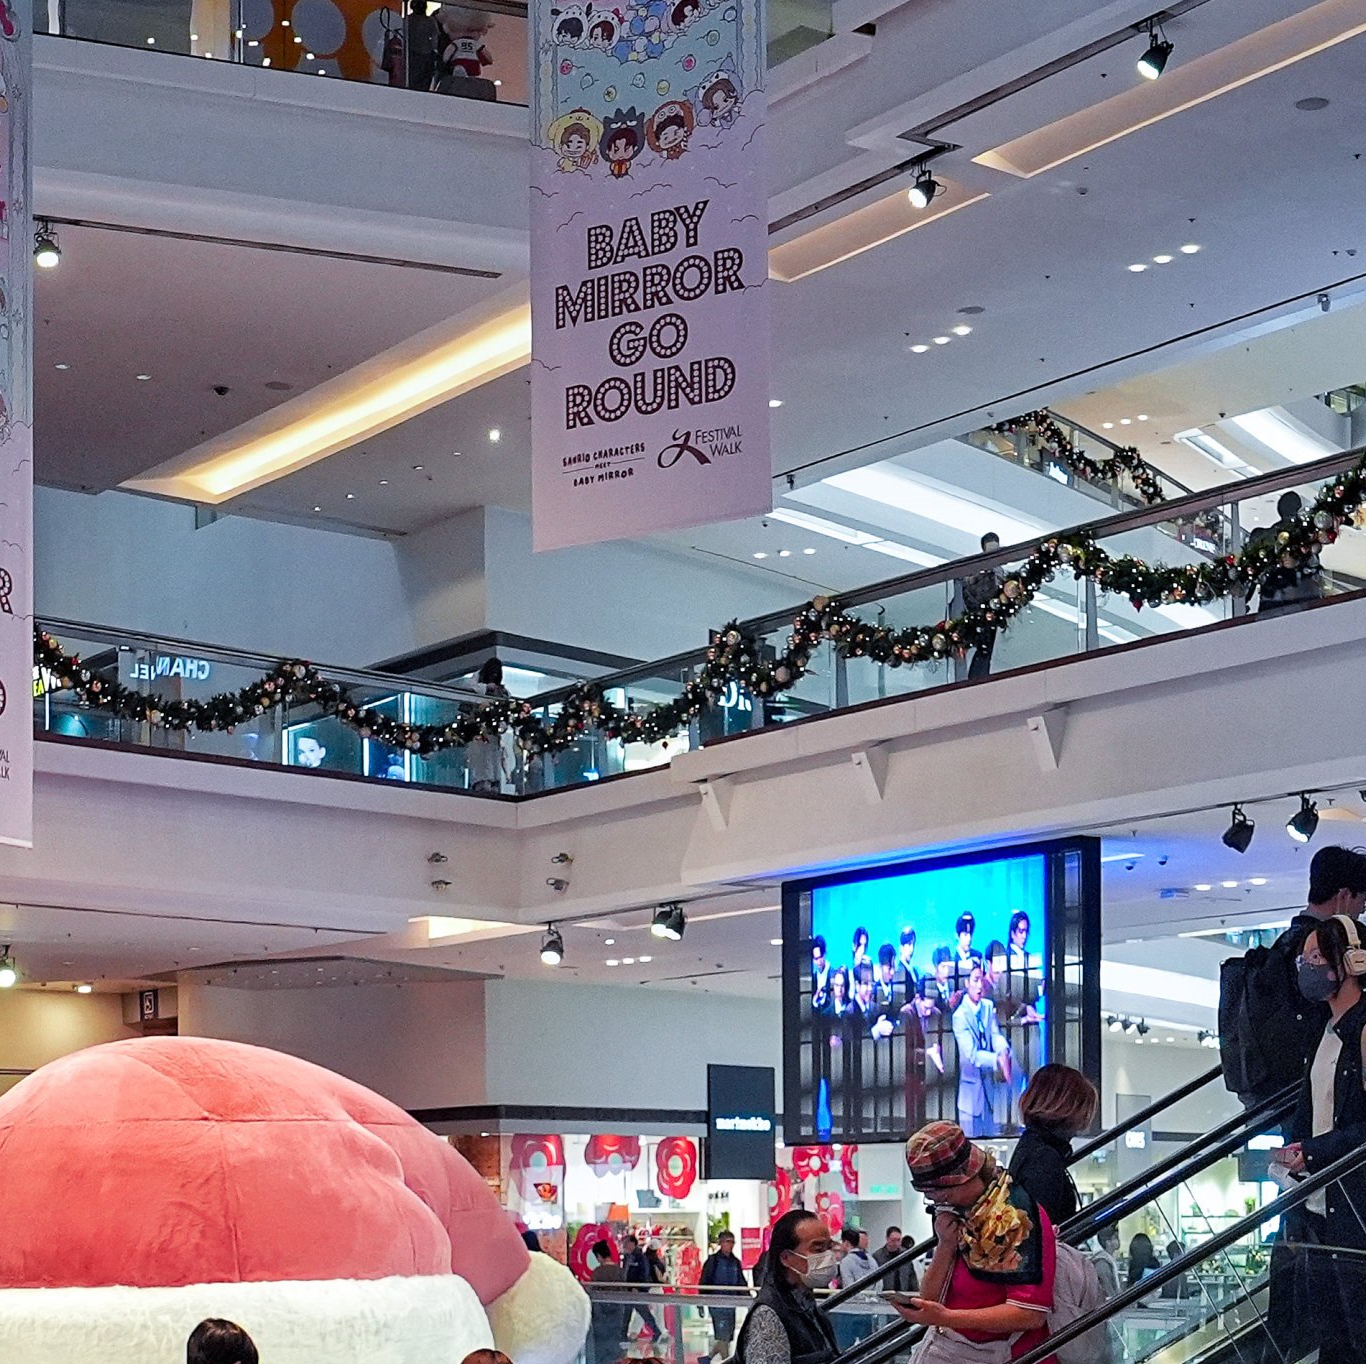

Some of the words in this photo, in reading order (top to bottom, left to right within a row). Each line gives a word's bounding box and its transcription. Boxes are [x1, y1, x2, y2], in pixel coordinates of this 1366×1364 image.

[587, 200, 710, 270] BABY
[555, 247, 745, 330] MIRROR
[609, 313, 688, 367] GO
[566, 356, 736, 430] ROUND
[695, 425, 742, 444] FESTIVAL
[709, 441, 742, 457] WALK
[562, 453, 590, 467] SANRIO
[593, 442, 645, 461] CHARACTERS
[574, 475, 595, 487] BABY
[597, 467, 634, 482] MIRROR
